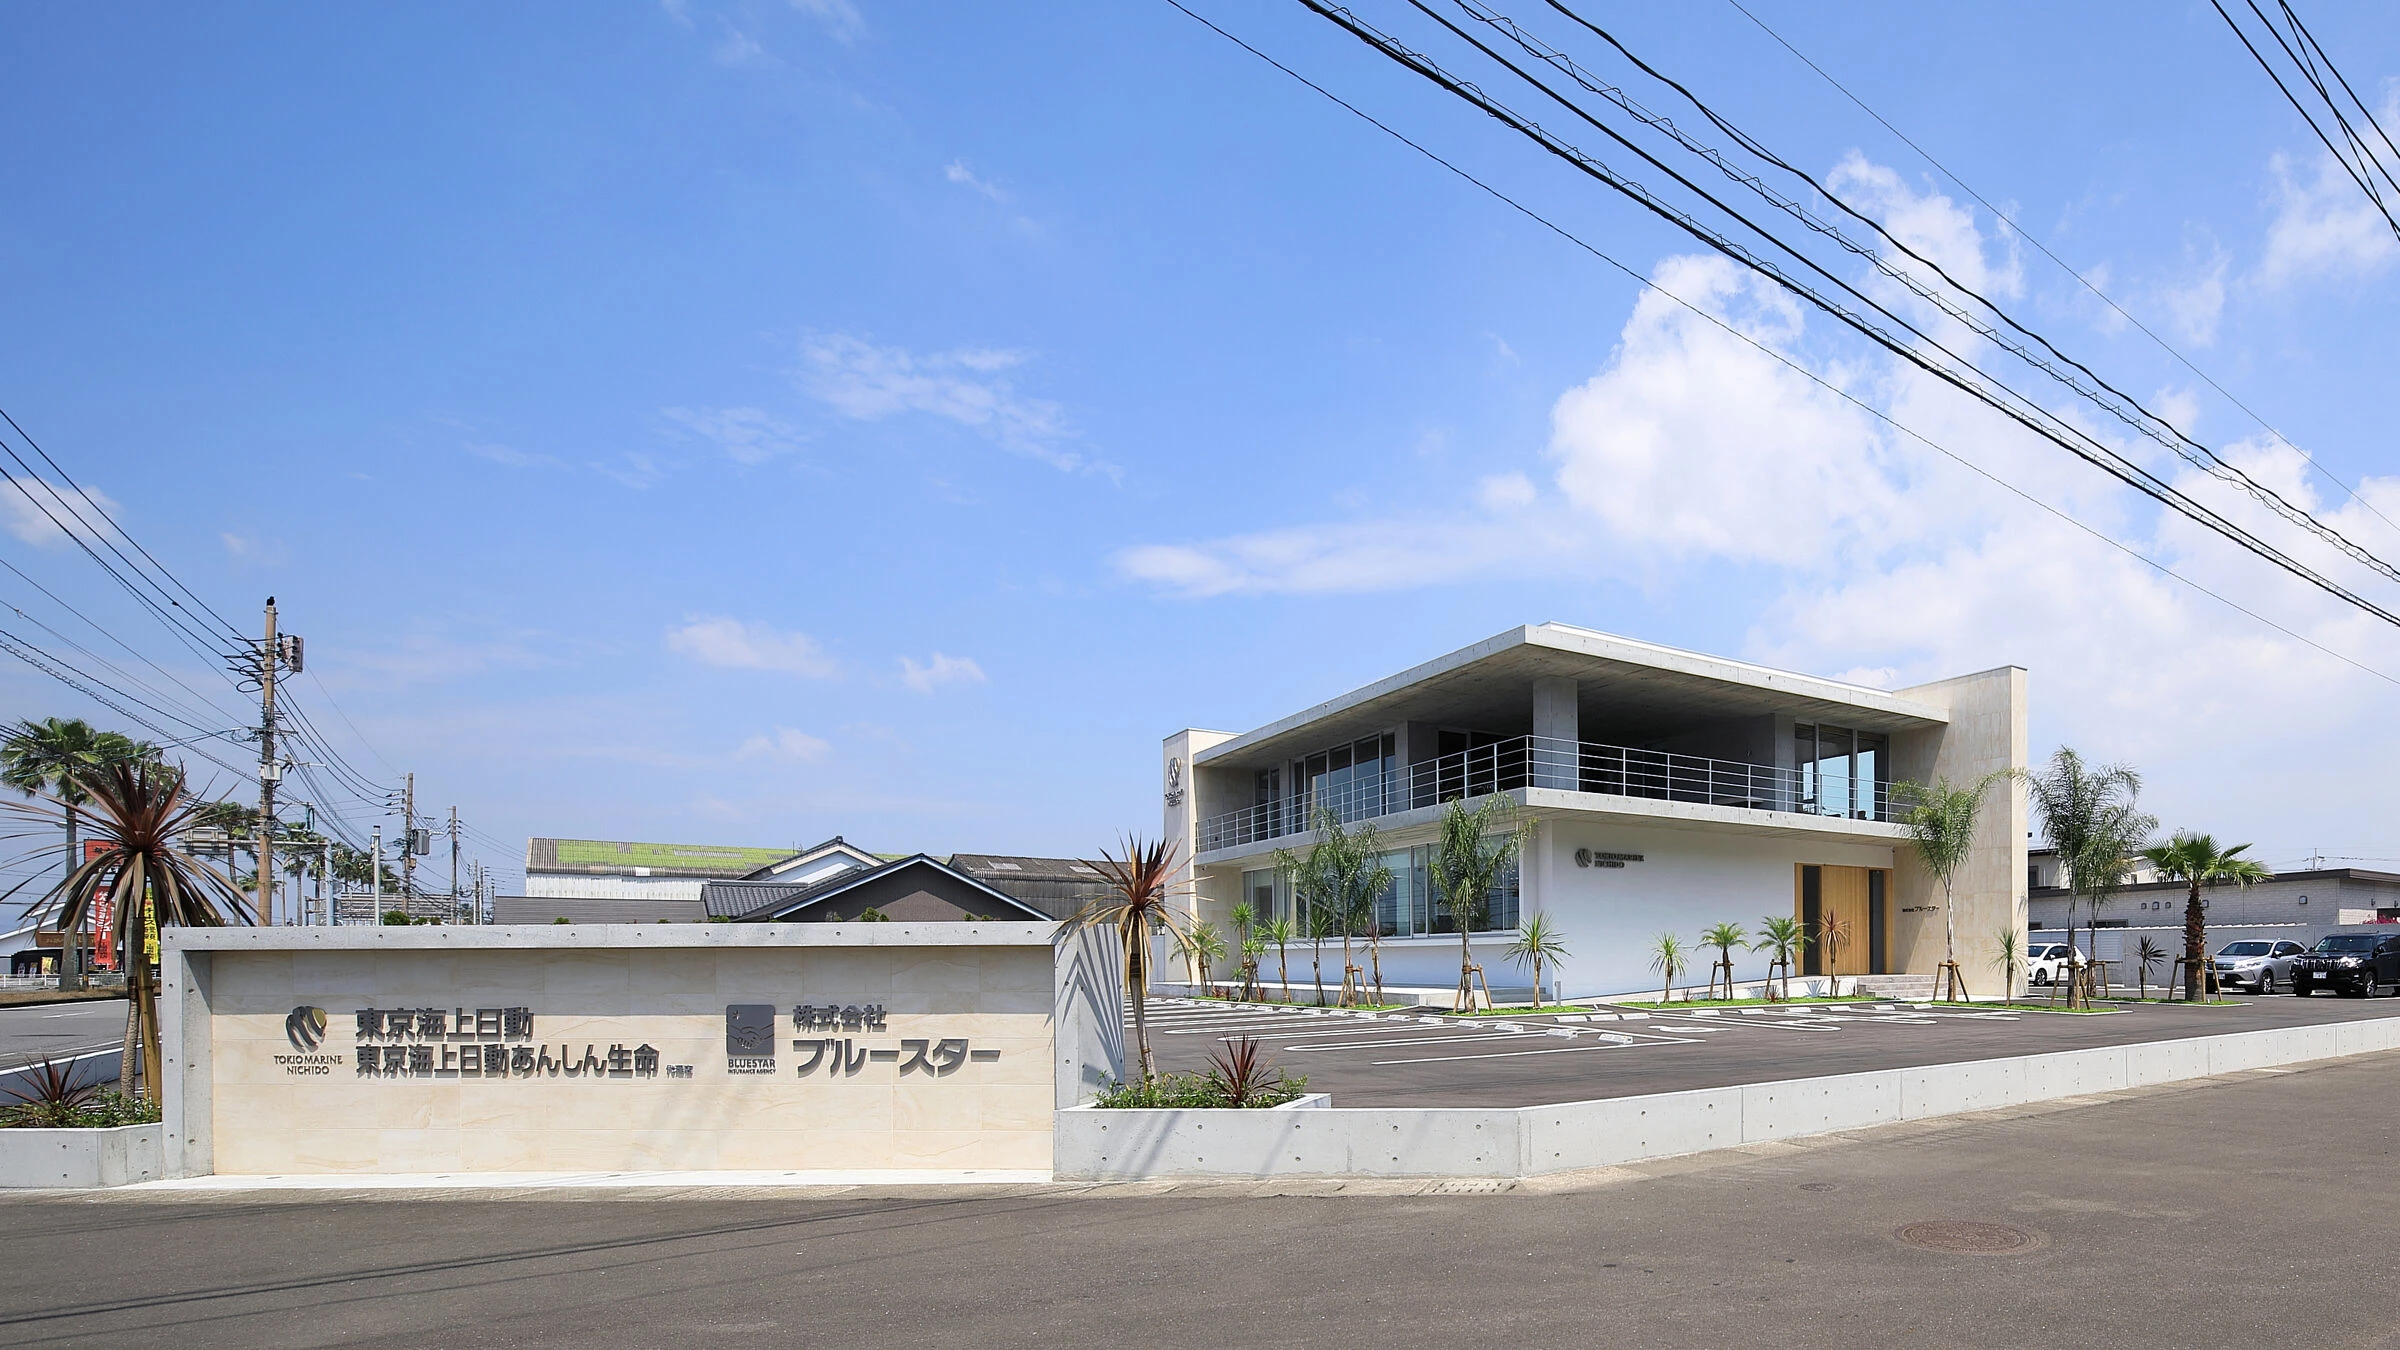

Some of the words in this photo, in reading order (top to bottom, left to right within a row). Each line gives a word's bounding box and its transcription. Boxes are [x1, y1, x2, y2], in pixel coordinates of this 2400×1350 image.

[356, 1007, 535, 1042] 東京海上日動
[793, 1004, 888, 1033] 株式会社
[274, 1055, 303, 1065] TOKIO
[304, 1055, 343, 1065] MARINE
[728, 1058, 776, 1069] BLUESTAR
[793, 1038, 1001, 1078] ブルースター
[286, 1065, 330, 1075] NICHIDO
